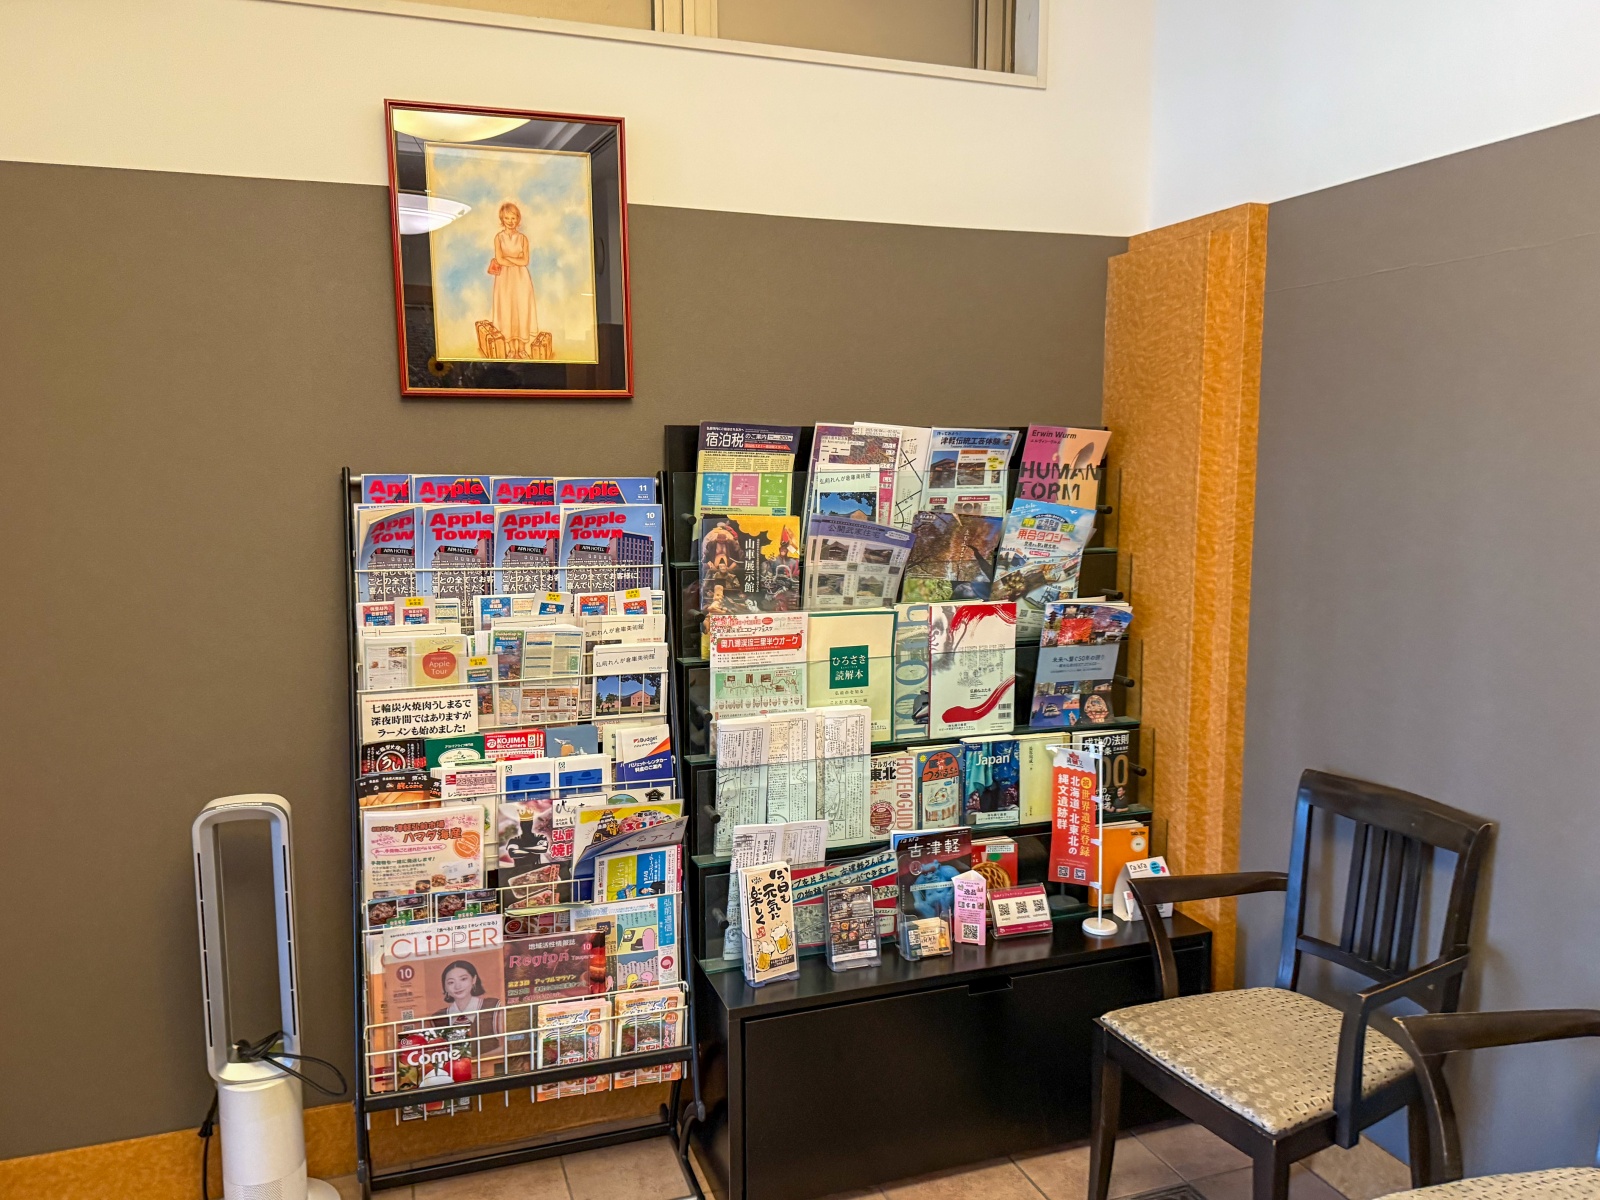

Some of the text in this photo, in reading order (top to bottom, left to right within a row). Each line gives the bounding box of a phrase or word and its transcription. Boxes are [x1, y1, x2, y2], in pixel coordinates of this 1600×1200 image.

[706, 432, 744, 448] 宿泊税
[1032, 430, 1077, 439] Erwin Wurm
[1020, 461, 1100, 480] HUMAN
[368, 479, 408, 497] App
[419, 480, 483, 498] Apple
[496, 482, 554, 500] Apple
[560, 483, 620, 500] Apple
[638, 484, 647, 492] 11
[1019, 481, 1080, 500] FORM
[430, 511, 494, 528] Apple
[502, 511, 560, 528] Apple
[569, 511, 626, 528] Apple
[370, 530, 414, 544] Tow
[432, 528, 492, 540] Town
[504, 528, 560, 540] Town
[570, 528, 623, 540] Town
[744, 538, 754, 592] 山車展示館
[585, 624, 644, 638] 弘前れんが倉庫美術館
[429, 660, 450, 669] Apple
[596, 654, 655, 668] 弘前れんが倉庫美術館
[832, 654, 866, 666] ひろさき
[835, 669, 864, 681] 読解本
[371, 699, 472, 714] 七輪炭火焼肉うしまるで
[371, 711, 472, 726] 深夜時間ではありますが
[976, 754, 1010, 768] Japan
[871, 767, 896, 781] 東北
[896, 758, 913, 830] HOTEL GUID
[1056, 774, 1070, 830] 縄文遺跡群
[1068, 776, 1080, 855] 北海道・北東北の
[1079, 789, 1091, 857] 世界遺産登録
[403, 828, 462, 844] ハマダ海産
[908, 838, 960, 858] 古津軽
[769, 868, 790, 904] 今日も
[750, 886, 766, 926] 楽しく
[762, 883, 782, 920] 元気に
[399, 968, 412, 979] 10
[407, 1048, 462, 1068] Come
